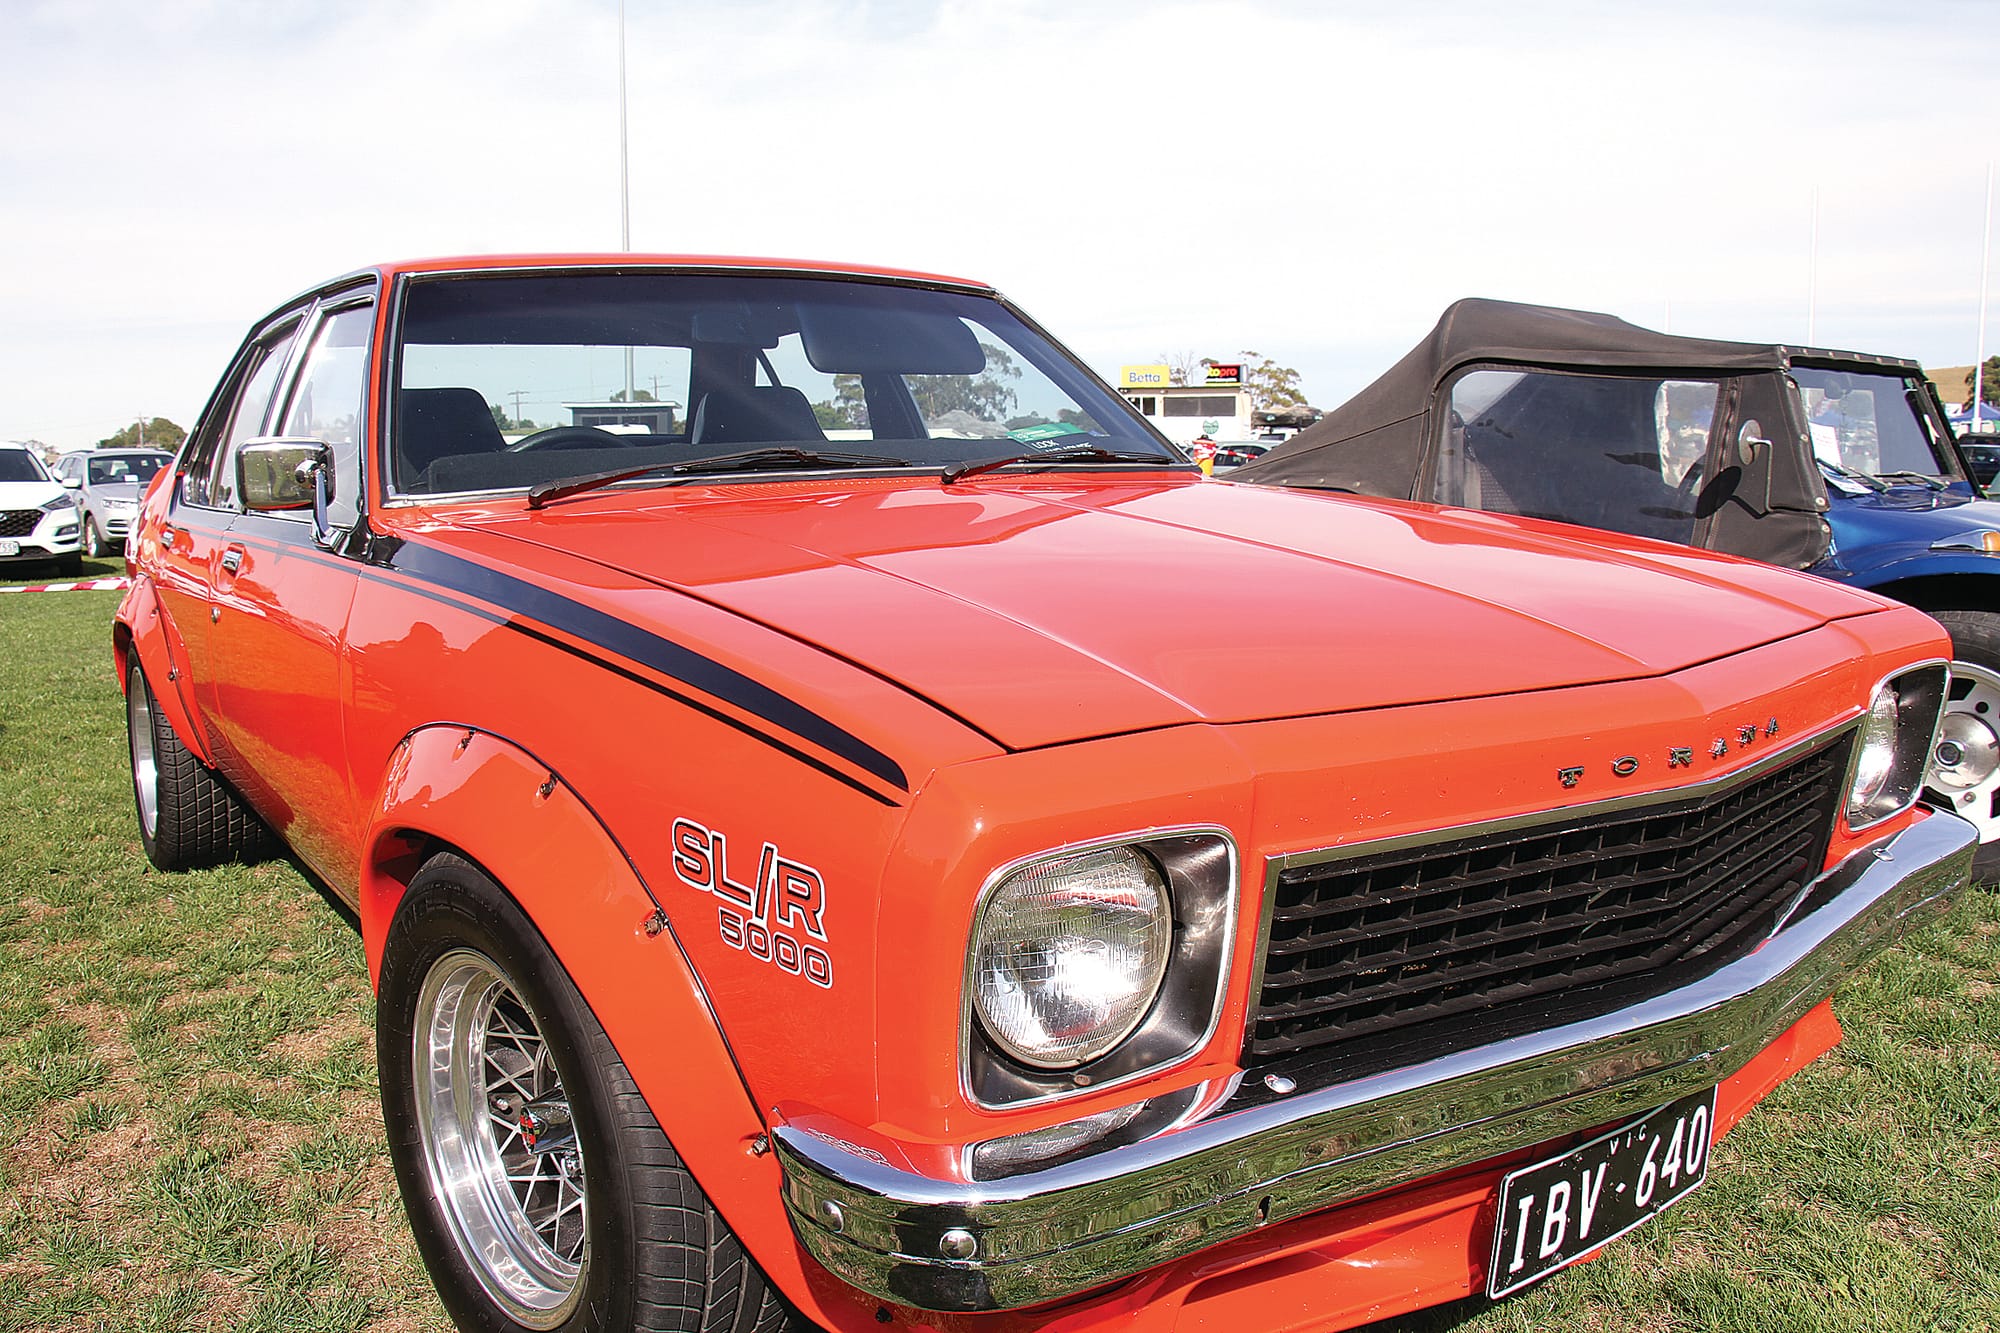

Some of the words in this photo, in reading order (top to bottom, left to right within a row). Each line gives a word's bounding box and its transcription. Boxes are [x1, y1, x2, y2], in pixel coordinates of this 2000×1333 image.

[1129, 372, 1160, 382] Betta
[1557, 716, 1779, 788] TORANA
[671, 816, 829, 943] SL/R
[718, 906, 833, 988] 5000
